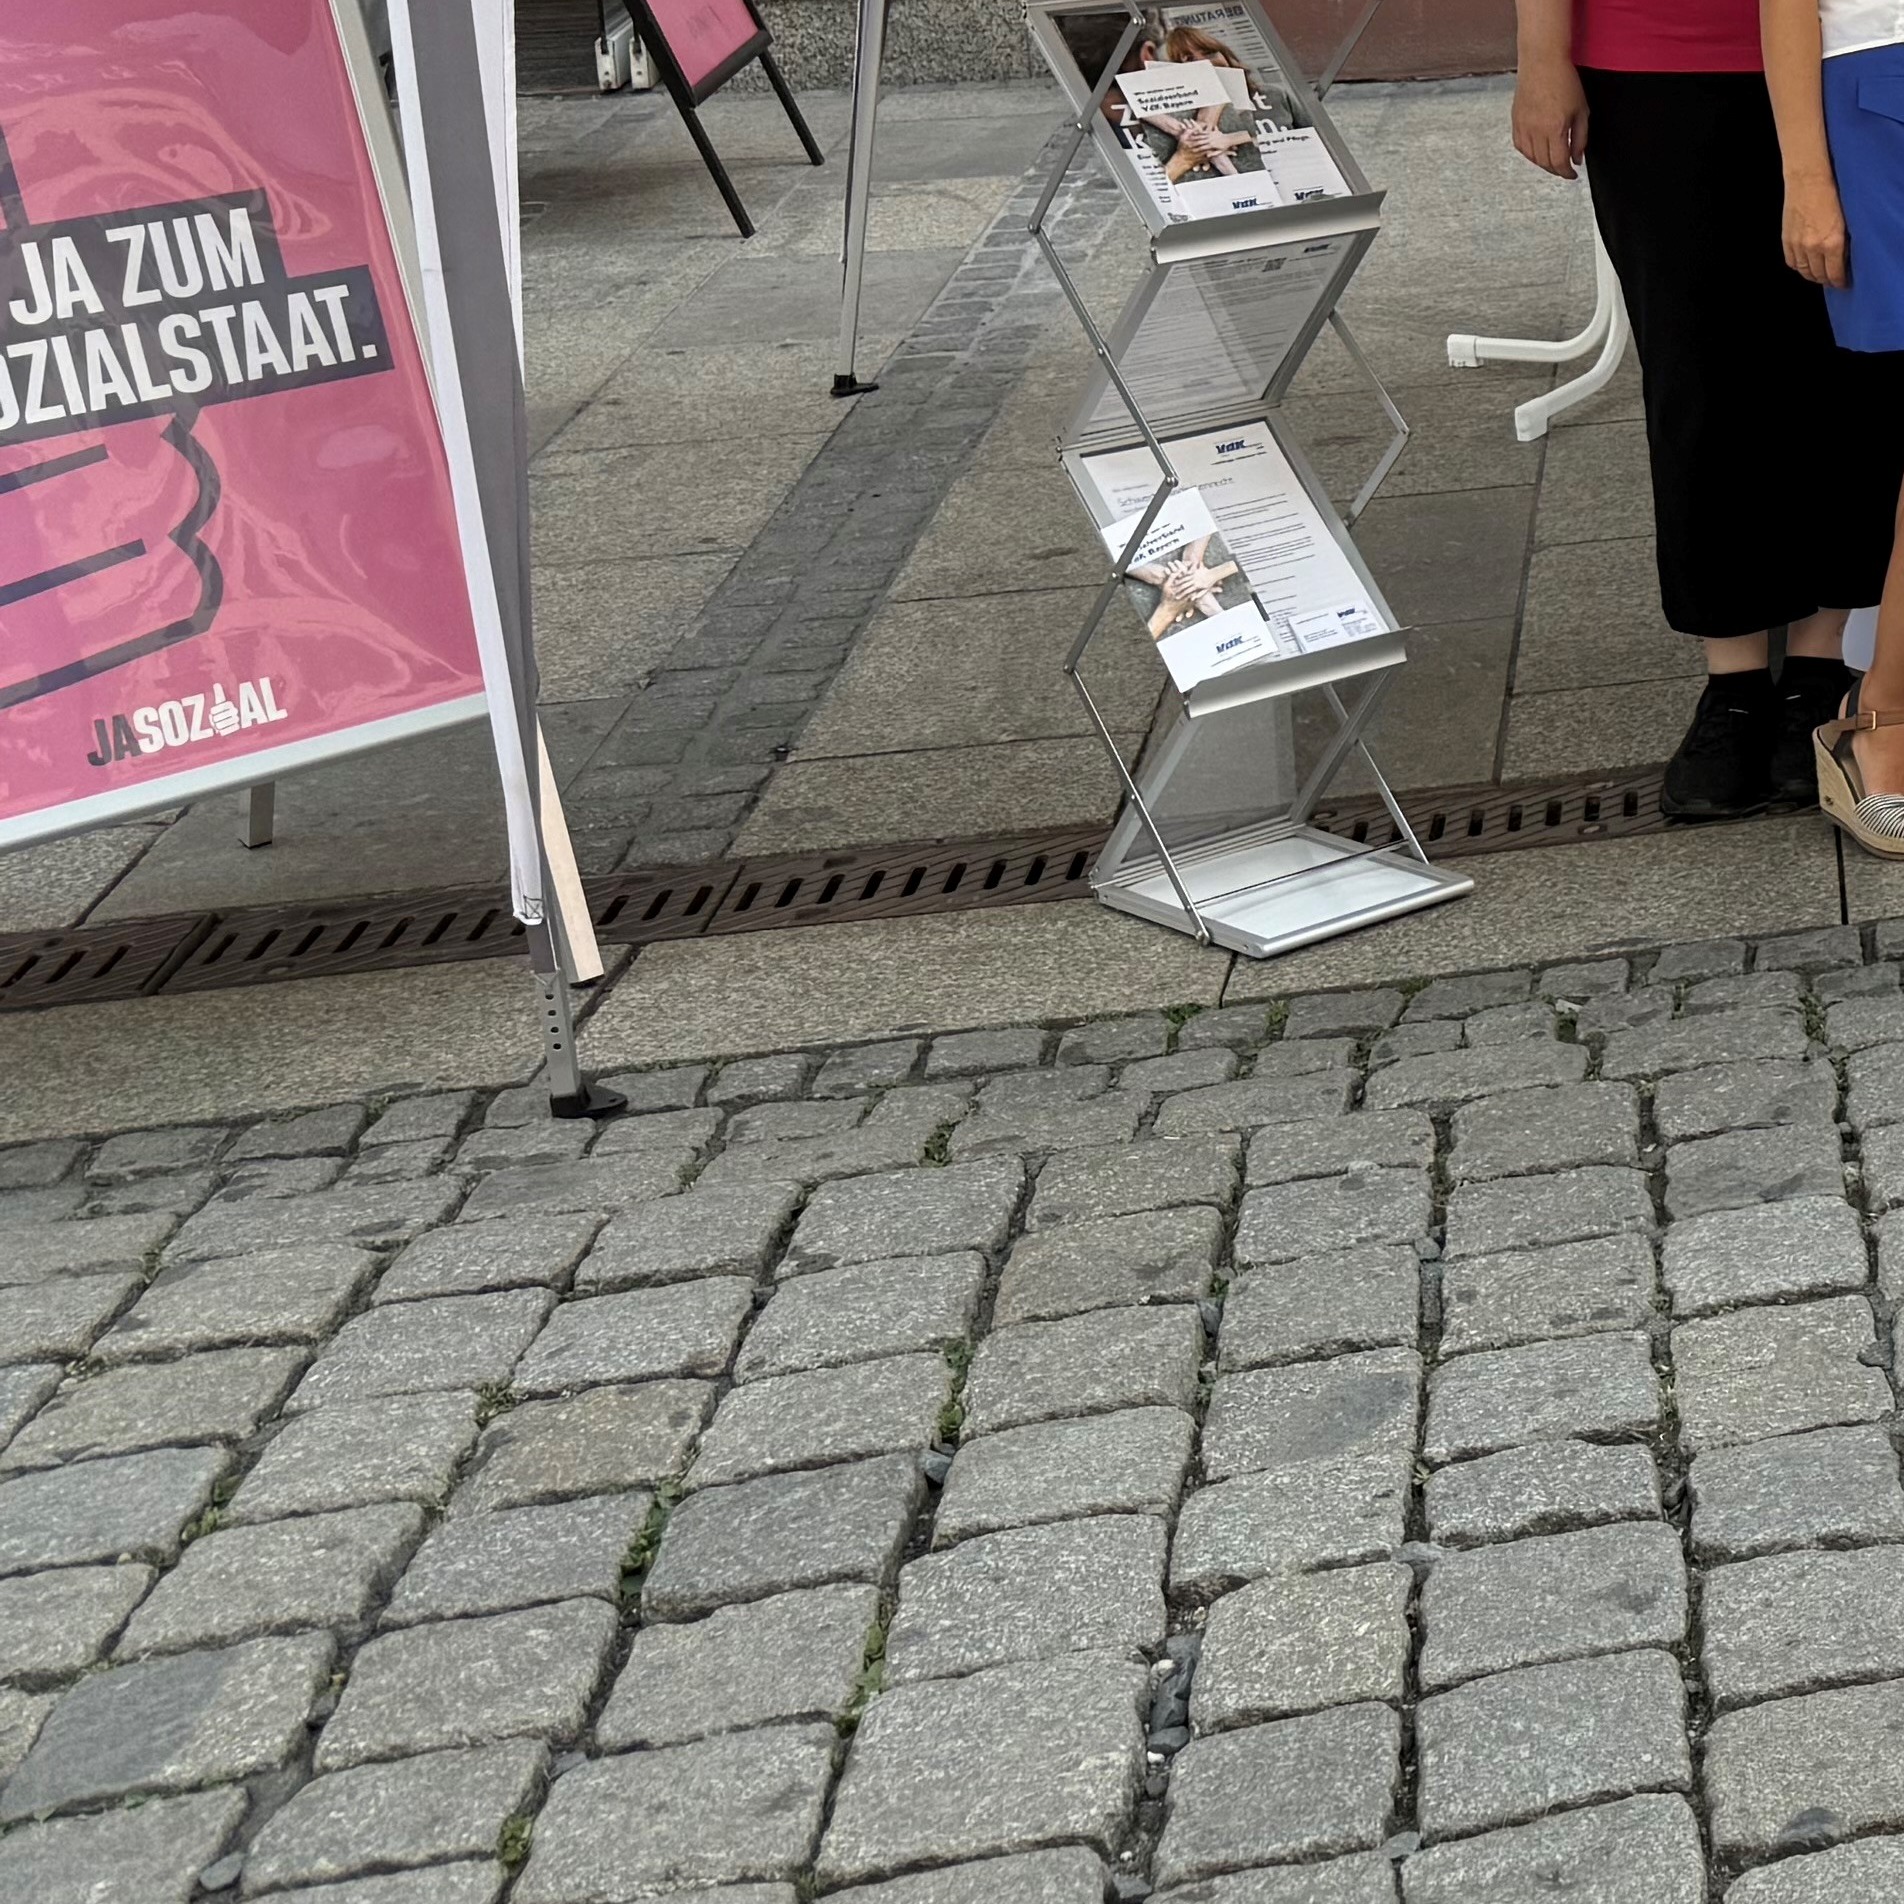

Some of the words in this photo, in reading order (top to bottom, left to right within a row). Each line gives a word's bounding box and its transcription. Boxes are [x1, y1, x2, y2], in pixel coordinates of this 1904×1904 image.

[9, 236, 106, 325] JA
[106, 207, 266, 308] ZUM
[0, 284, 377, 433] ZIALSTAAT.
